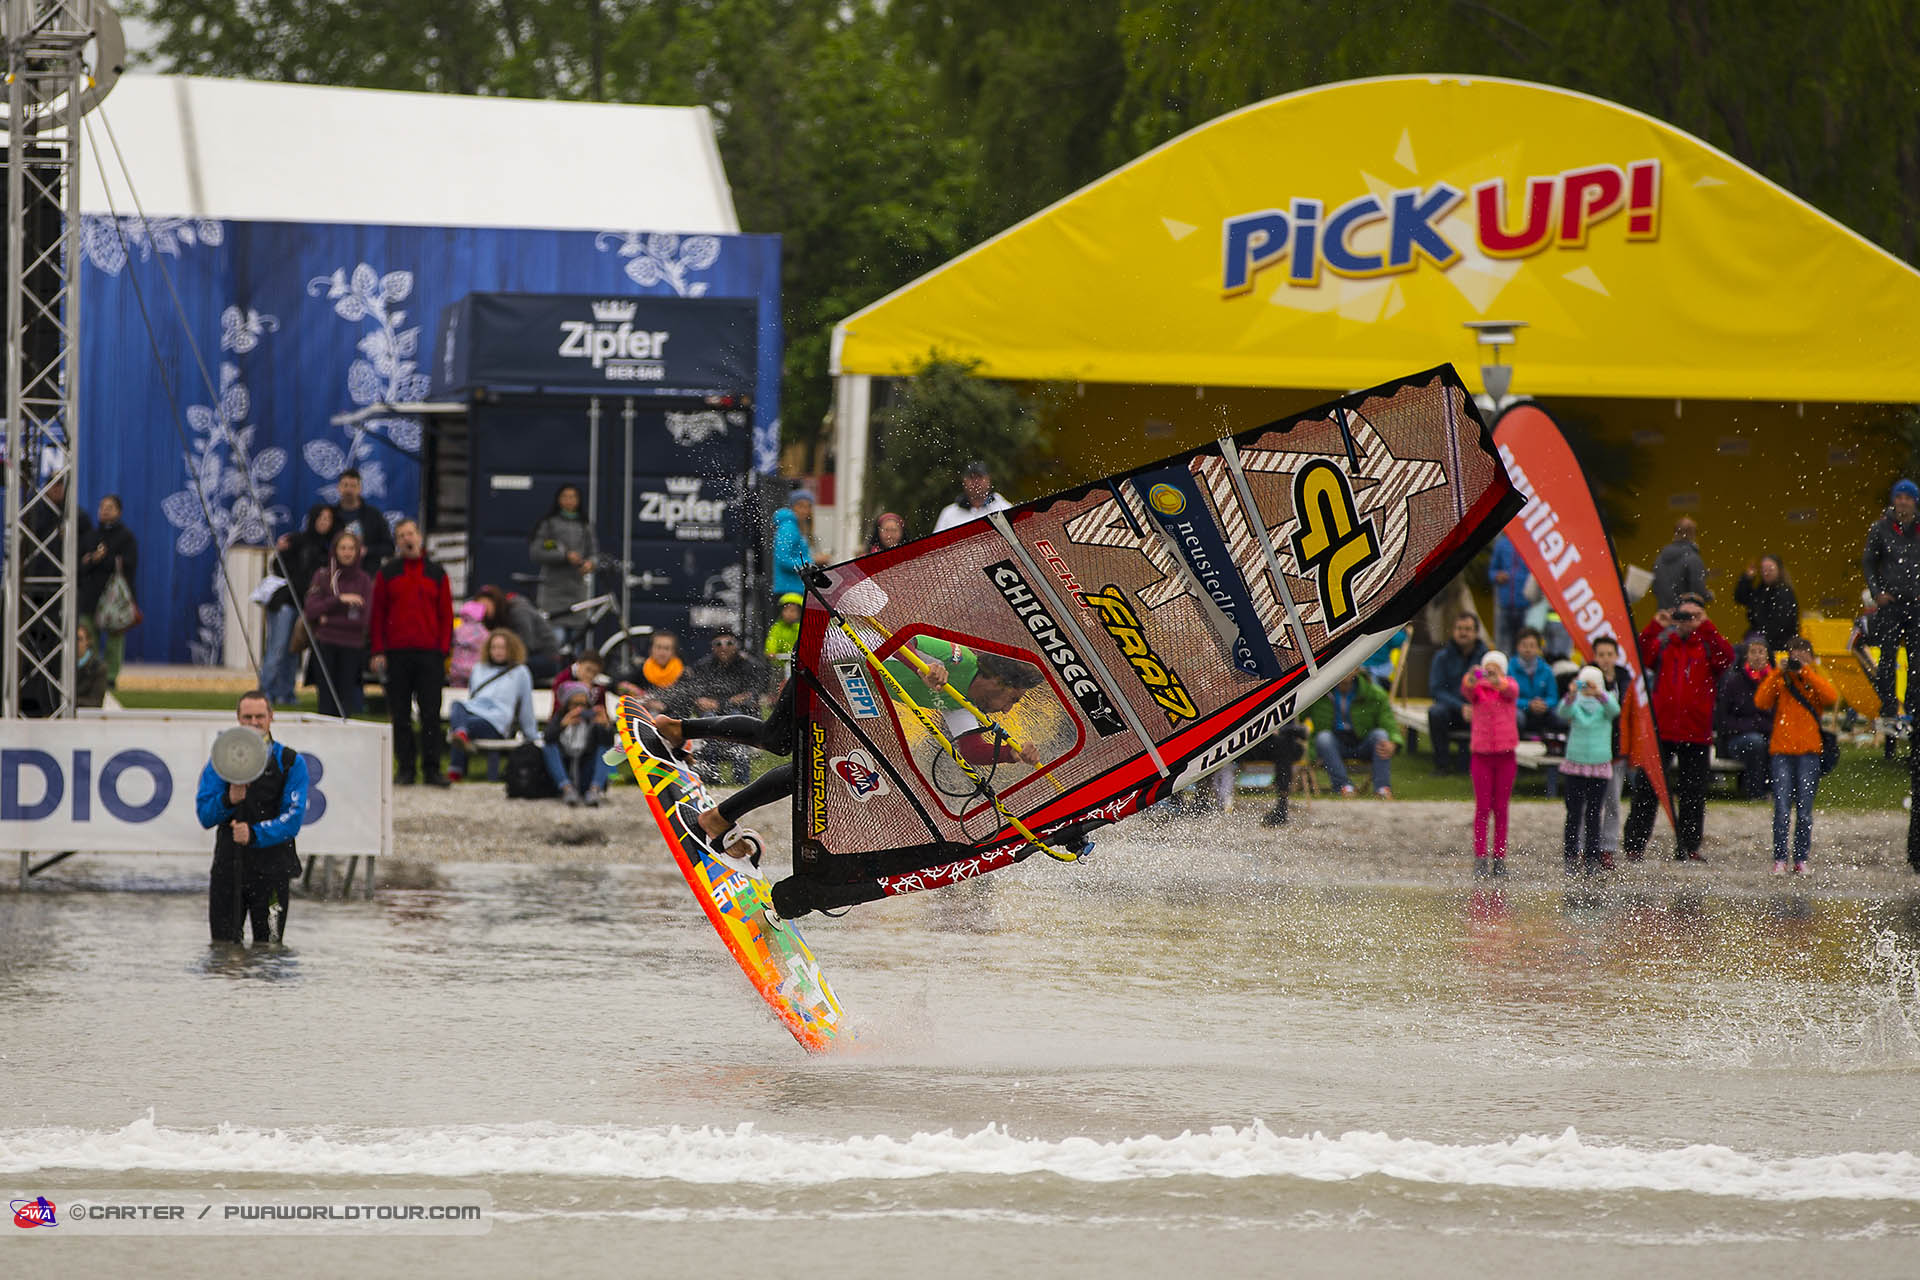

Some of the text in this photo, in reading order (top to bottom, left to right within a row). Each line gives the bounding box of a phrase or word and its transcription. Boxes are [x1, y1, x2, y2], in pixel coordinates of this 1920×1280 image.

[1472, 158, 1661, 260] UP!
[558, 320, 669, 368] Zipfer
[638, 491, 727, 531] Zipfer
[1034, 539, 1090, 609] ECHO
[993, 566, 1099, 698] CHIEMSEE
[845, 678, 880, 718] EFPT
[812, 721, 827, 835] JP-AUSTRALIA
[844, 762, 871, 791] PWA
